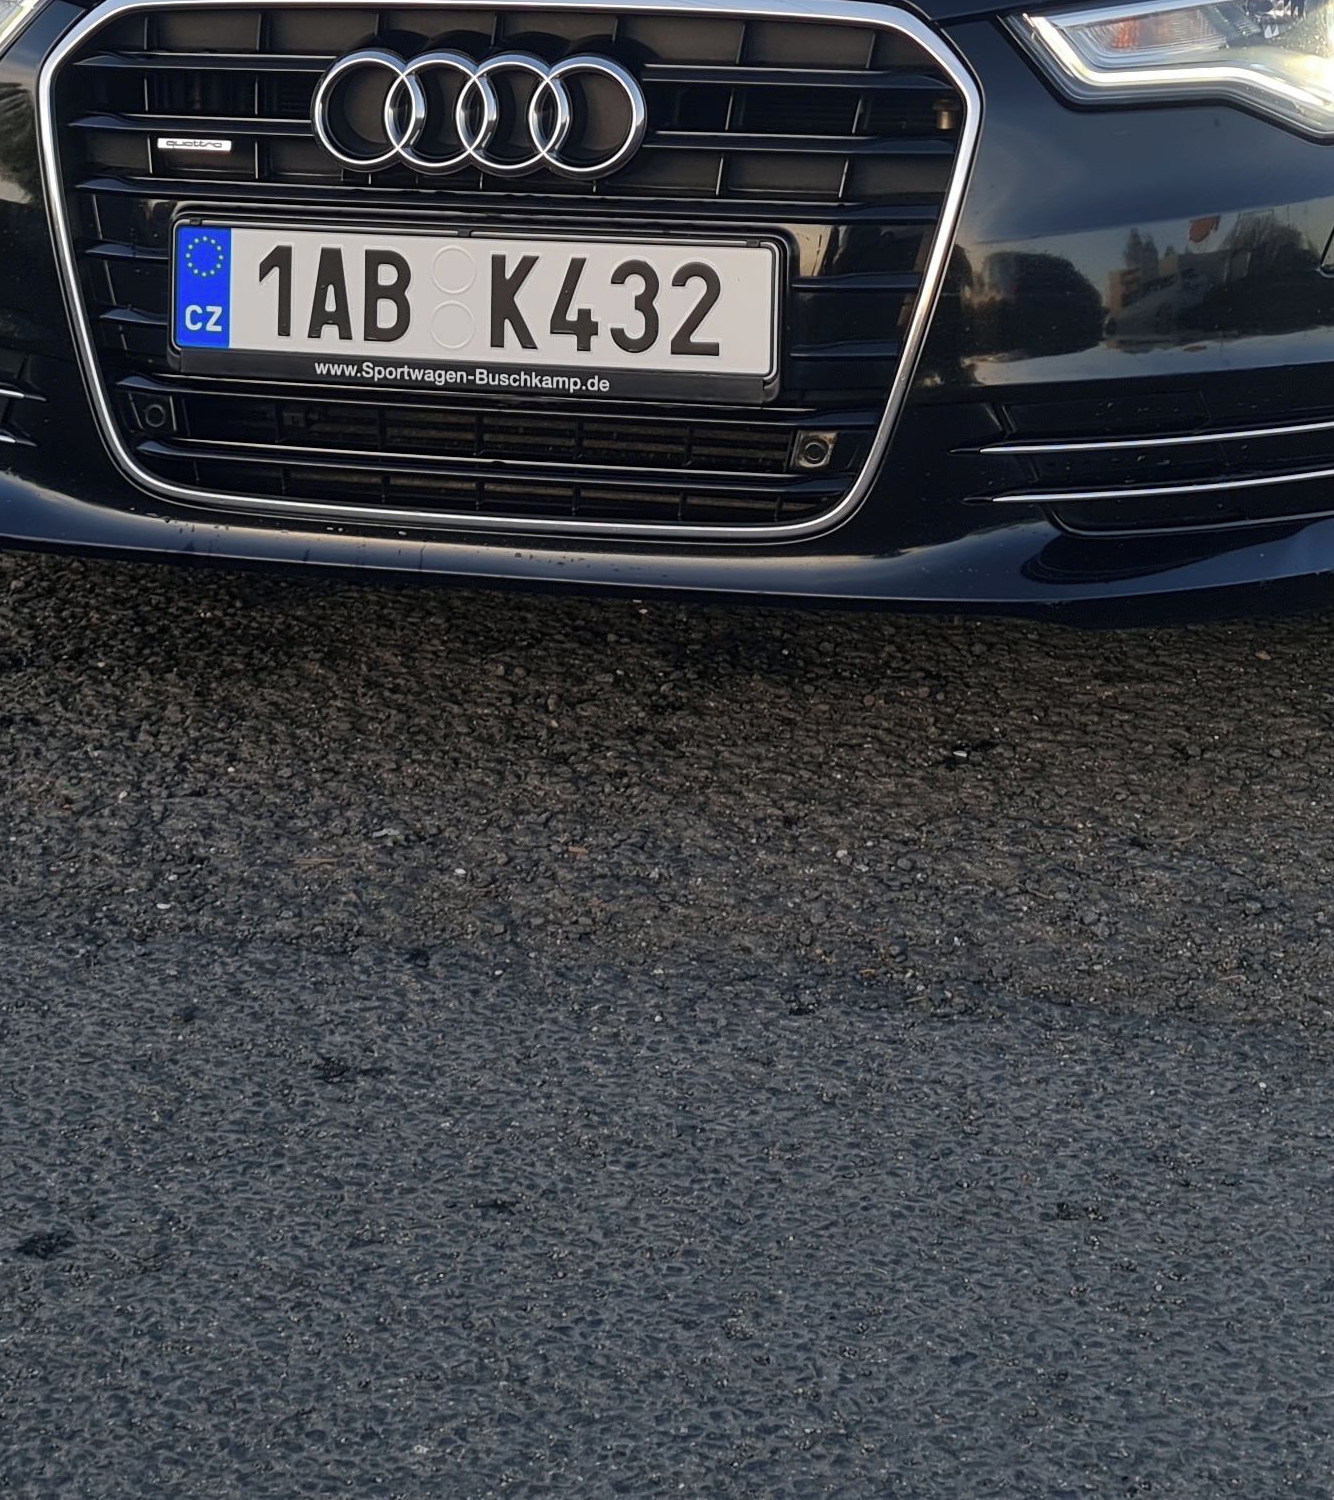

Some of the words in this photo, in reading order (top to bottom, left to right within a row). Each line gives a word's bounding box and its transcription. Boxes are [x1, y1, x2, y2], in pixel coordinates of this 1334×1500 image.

[166, 140, 223, 149] quattro
[184, 304, 223, 332] CZ
[258, 244, 412, 342] 1AB
[489, 253, 721, 356] K432
[314, 361, 611, 393] www.Sportwagen-Buschkamp.de
